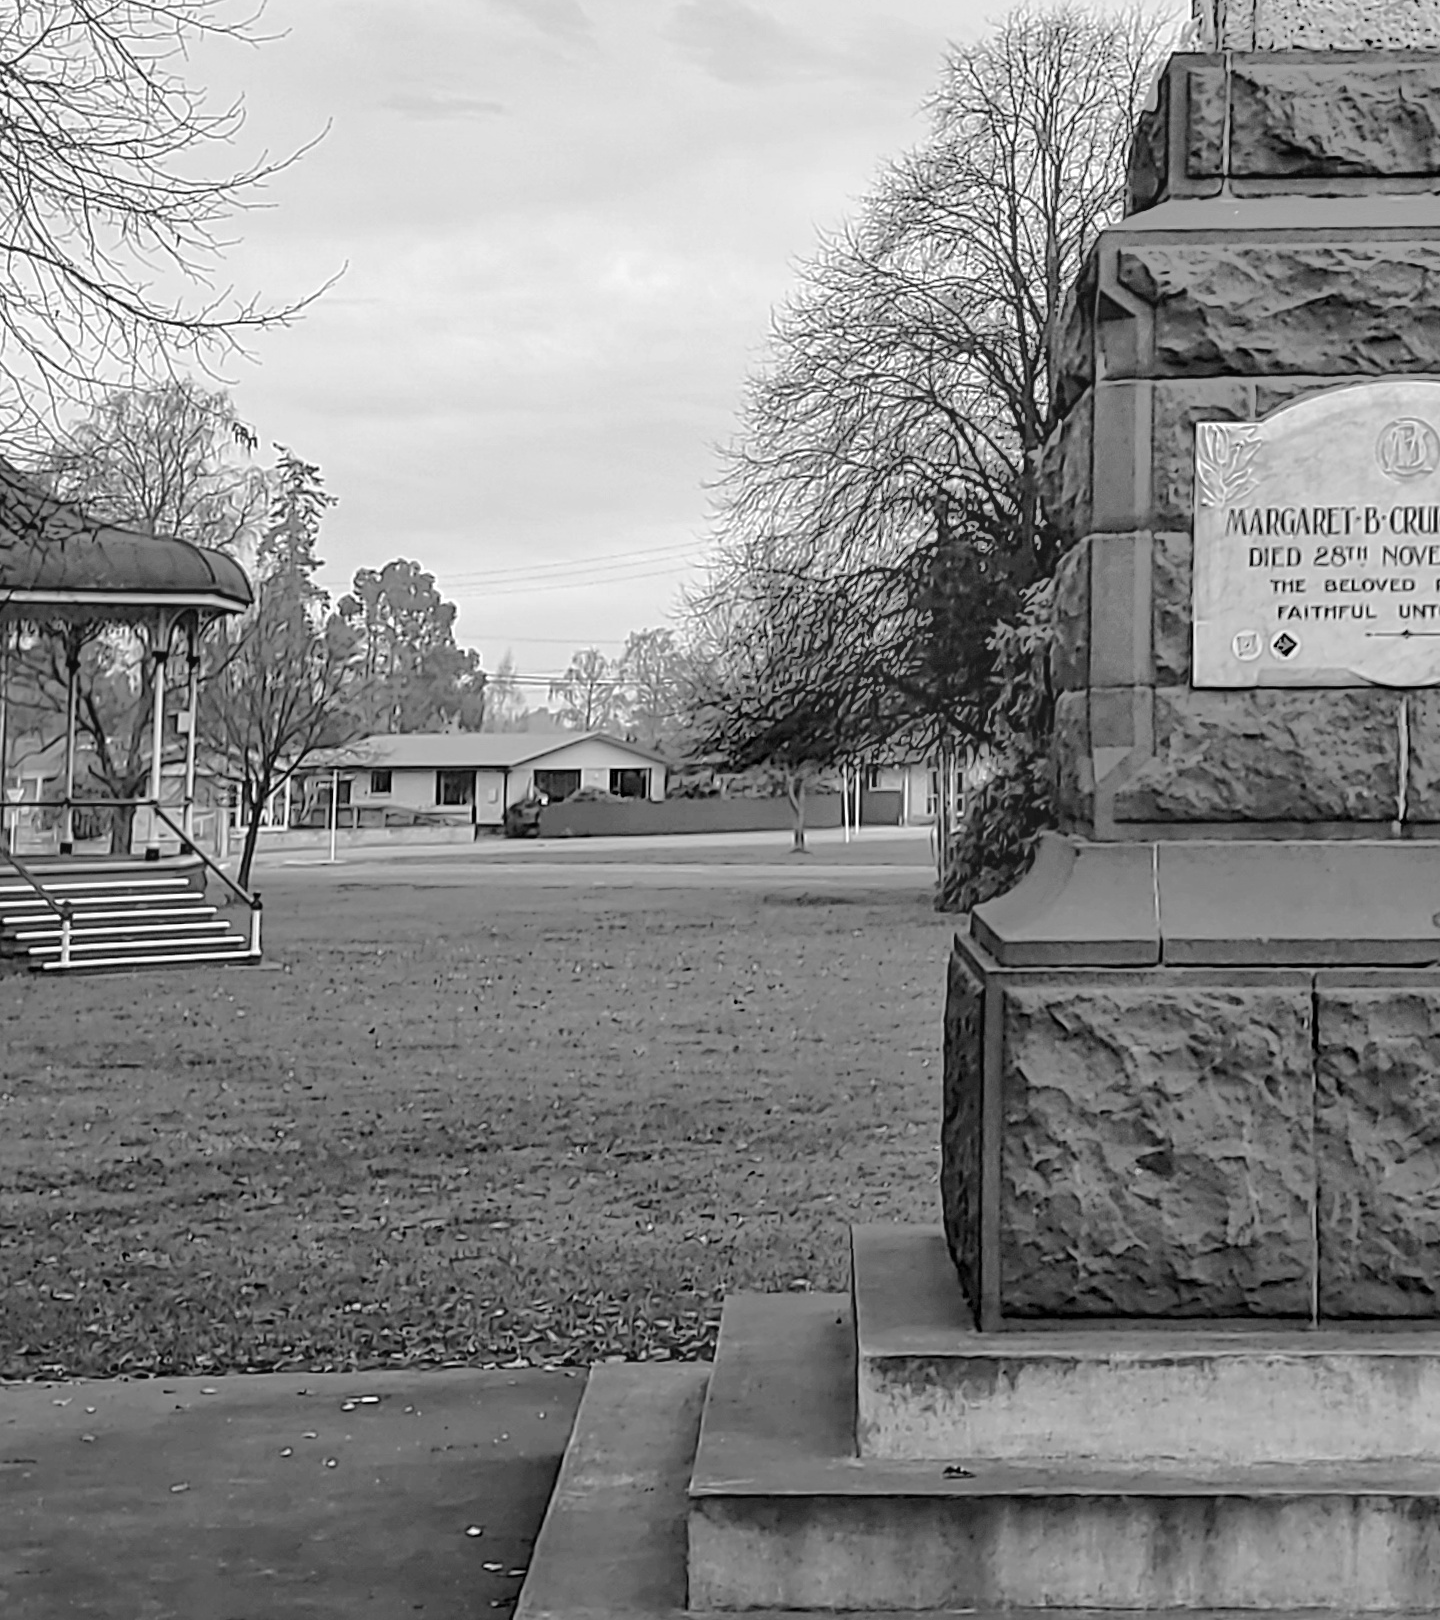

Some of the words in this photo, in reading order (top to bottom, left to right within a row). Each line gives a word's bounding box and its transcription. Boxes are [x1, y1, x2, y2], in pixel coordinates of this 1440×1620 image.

[1249, 545, 1301, 568] DIED
[1313, 545, 1368, 568] 28TH
[1269, 578, 1307, 594] THE
[1325, 577, 1416, 593] BELOVED
[1277, 604, 1378, 620] FAITHFUL
